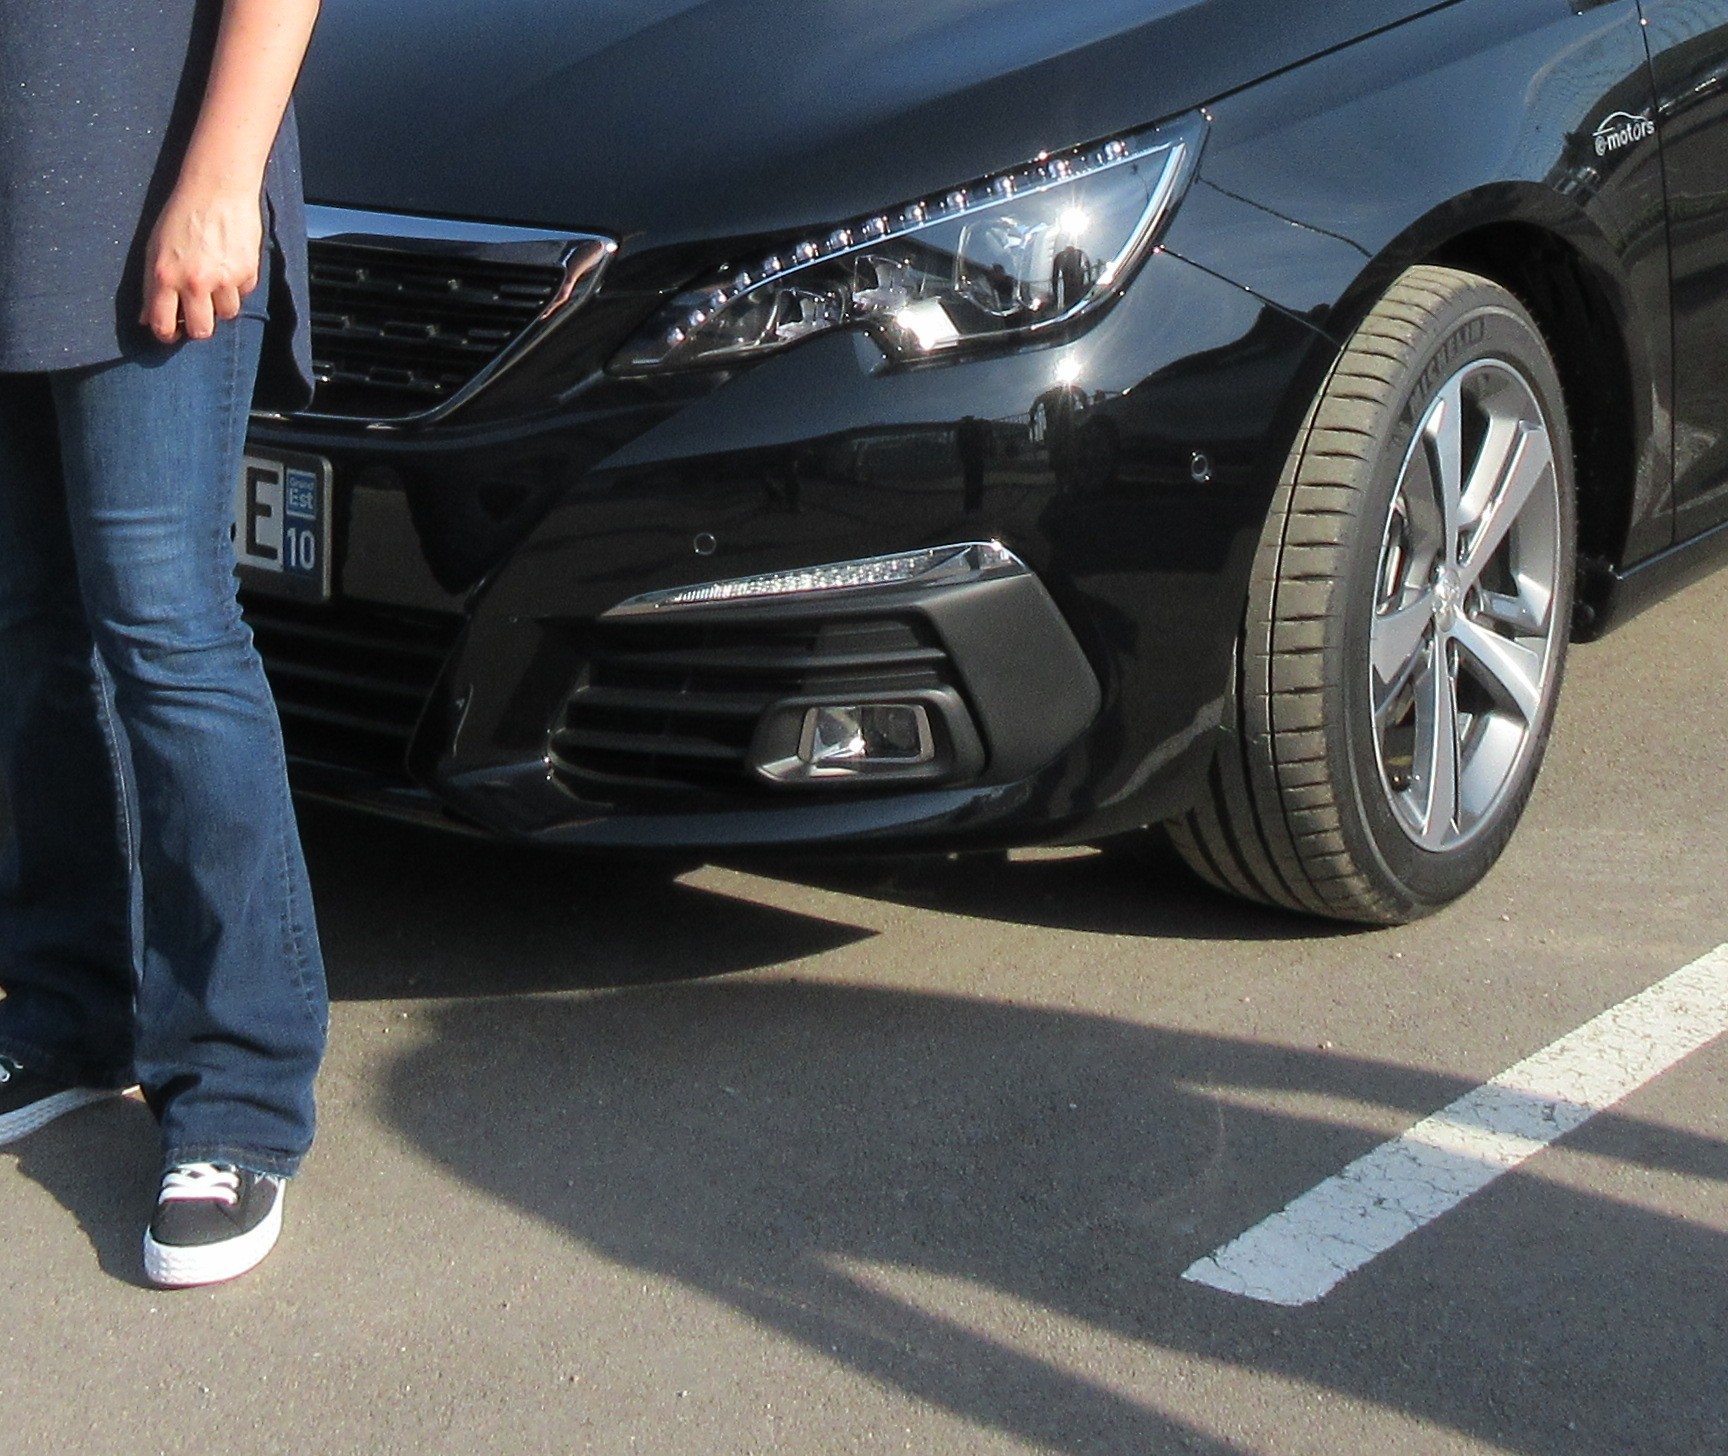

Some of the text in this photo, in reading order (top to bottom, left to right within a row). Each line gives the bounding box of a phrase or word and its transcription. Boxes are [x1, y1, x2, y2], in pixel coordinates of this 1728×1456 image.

[230, 466, 279, 561] E
[289, 487, 314, 510] Est
[286, 527, 316, 570] 10
